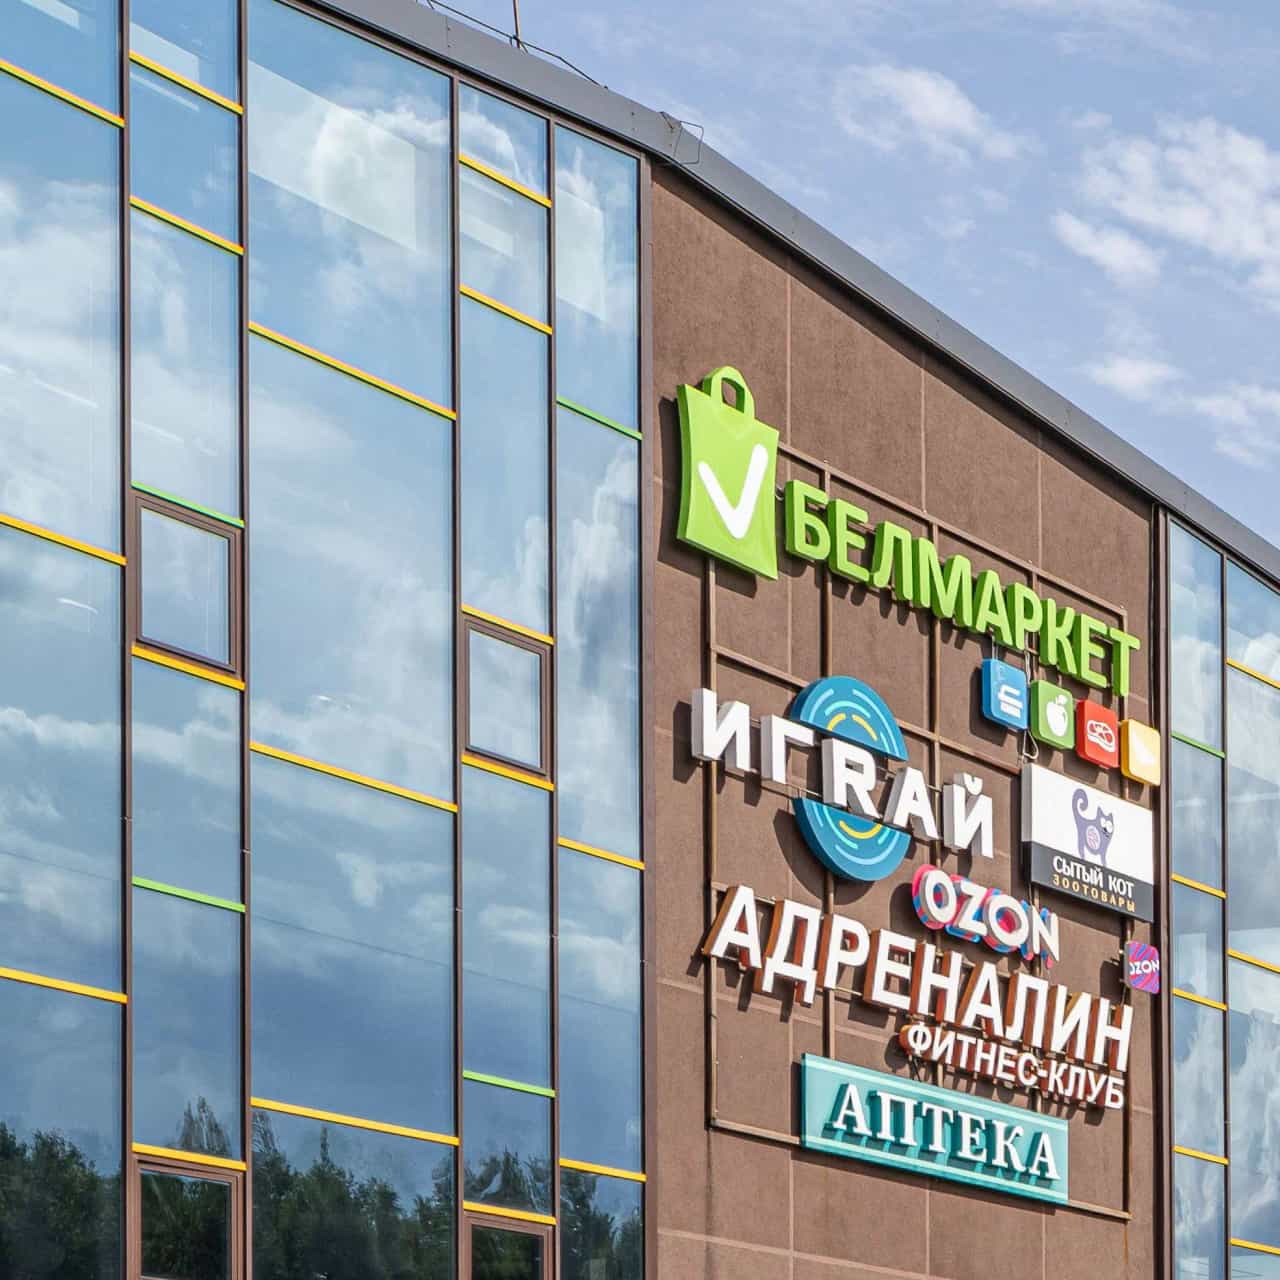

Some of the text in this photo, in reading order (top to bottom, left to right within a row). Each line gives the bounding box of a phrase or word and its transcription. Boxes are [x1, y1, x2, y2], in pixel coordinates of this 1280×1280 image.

[785, 480, 1141, 698] БЕЛМАРКЕТ
[918, 866, 1060, 964] OZON
[1052, 855, 1134, 899] СЫТЫЙ КОТ
[1052, 874, 1136, 913] ЗООТОВАРЫ
[704, 885, 1134, 1072] АДРЕНАЛИН
[905, 1023, 1124, 1110] ФИТНЕС-КЛУБ
[832, 1083, 1060, 1180] АПТЕКА
